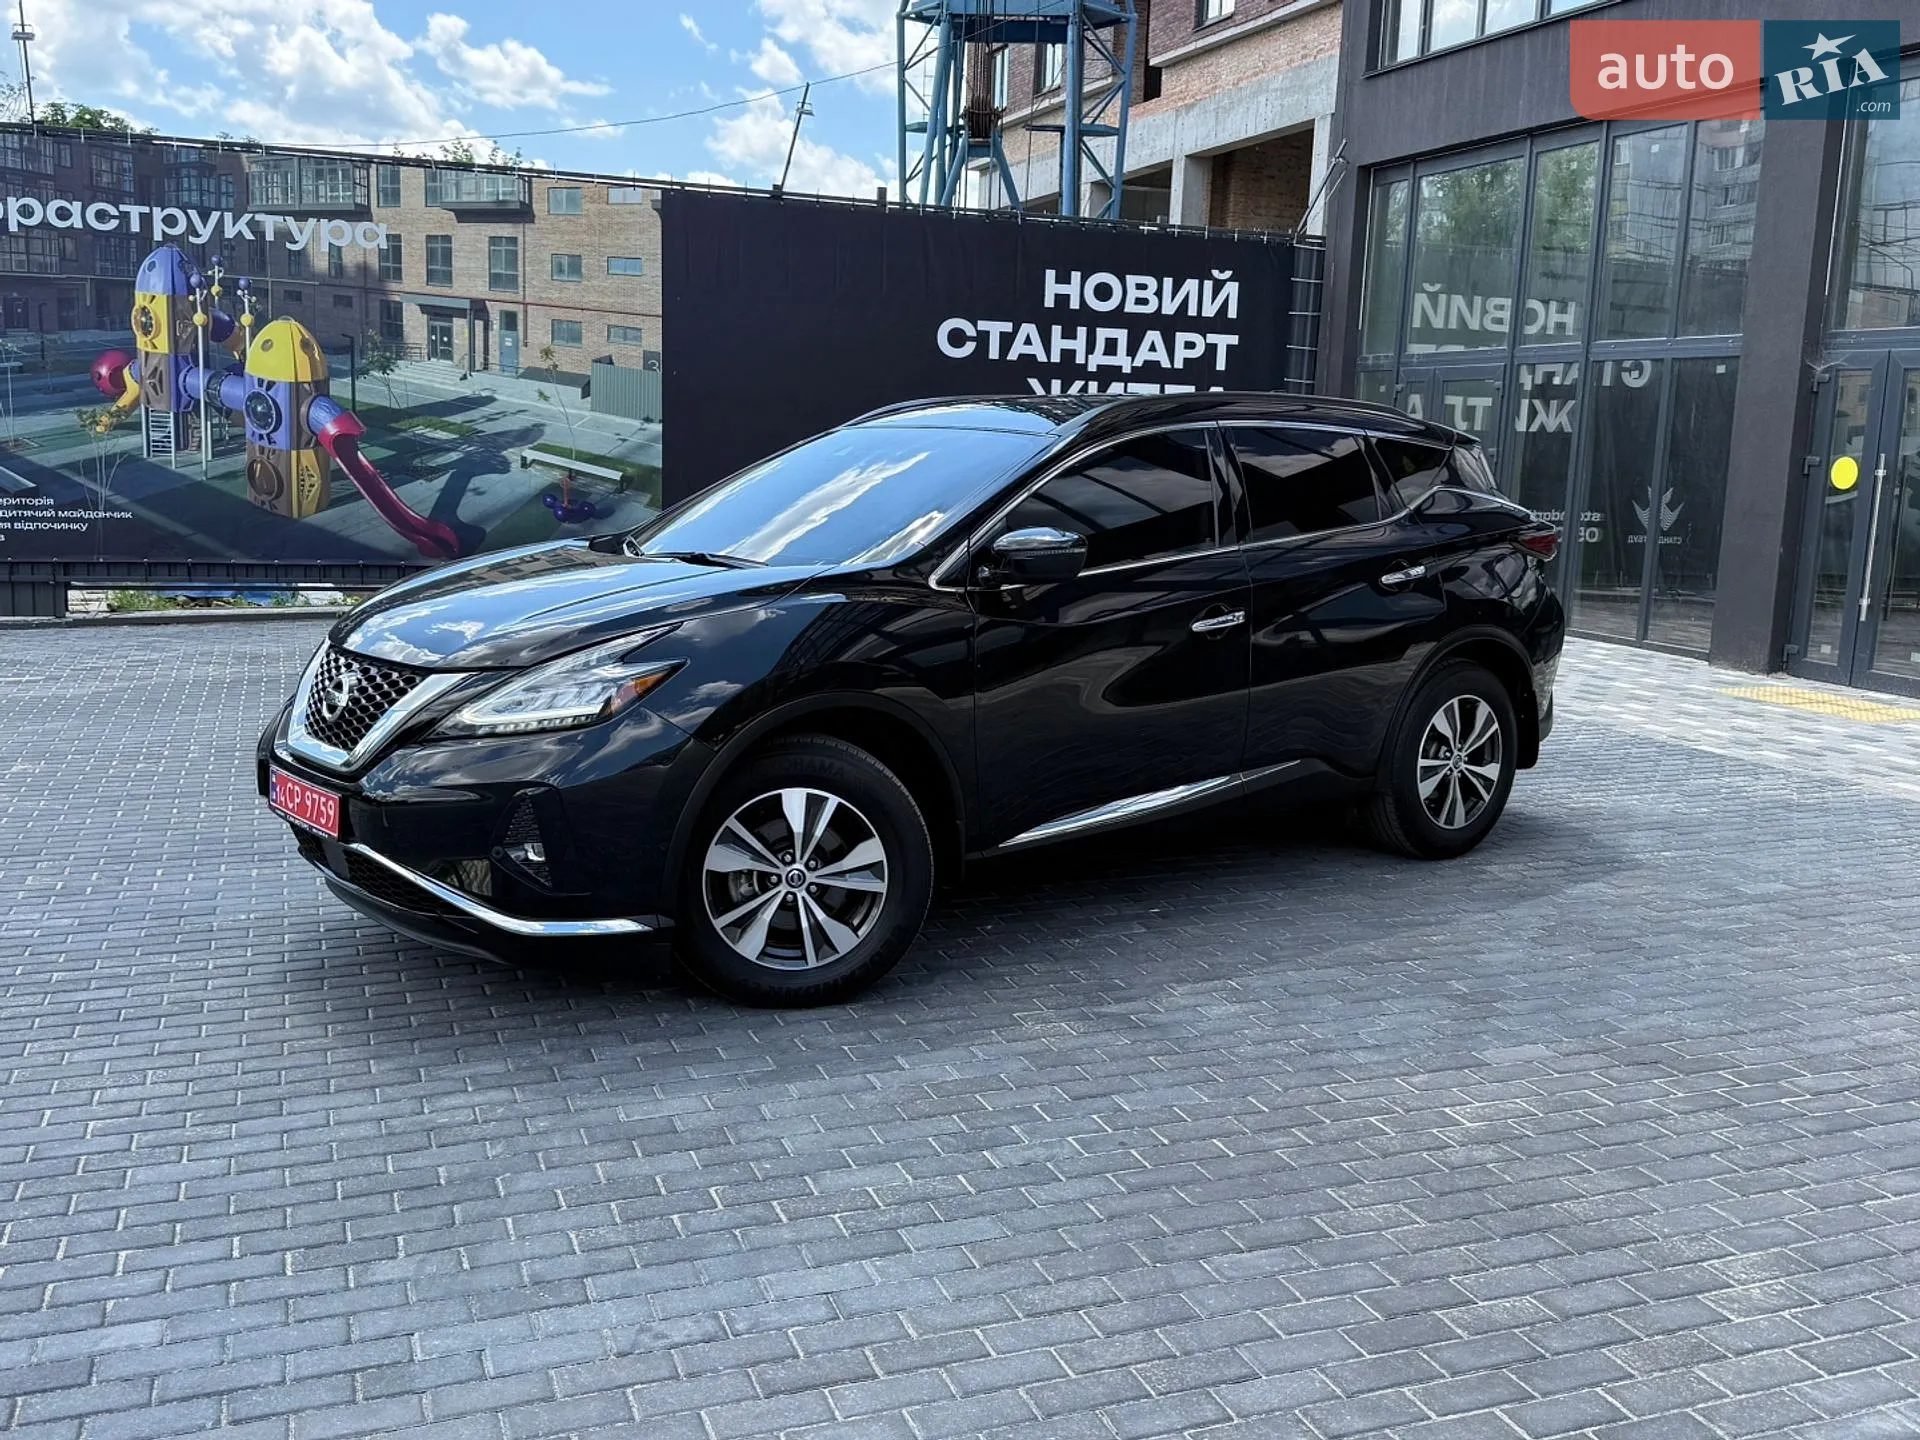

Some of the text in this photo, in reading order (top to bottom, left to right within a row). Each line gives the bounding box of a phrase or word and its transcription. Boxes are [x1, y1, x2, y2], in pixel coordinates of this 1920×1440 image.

[0, 195, 388, 250] раструктура
[1044, 269, 1239, 318] НОВИЙ
[937, 317, 1239, 373] СТАНДАРТ
[14, 520, 88, 531] відпочинку
[58, 509, 133, 519] майданчик
[305, 791, 335, 828] 9759
